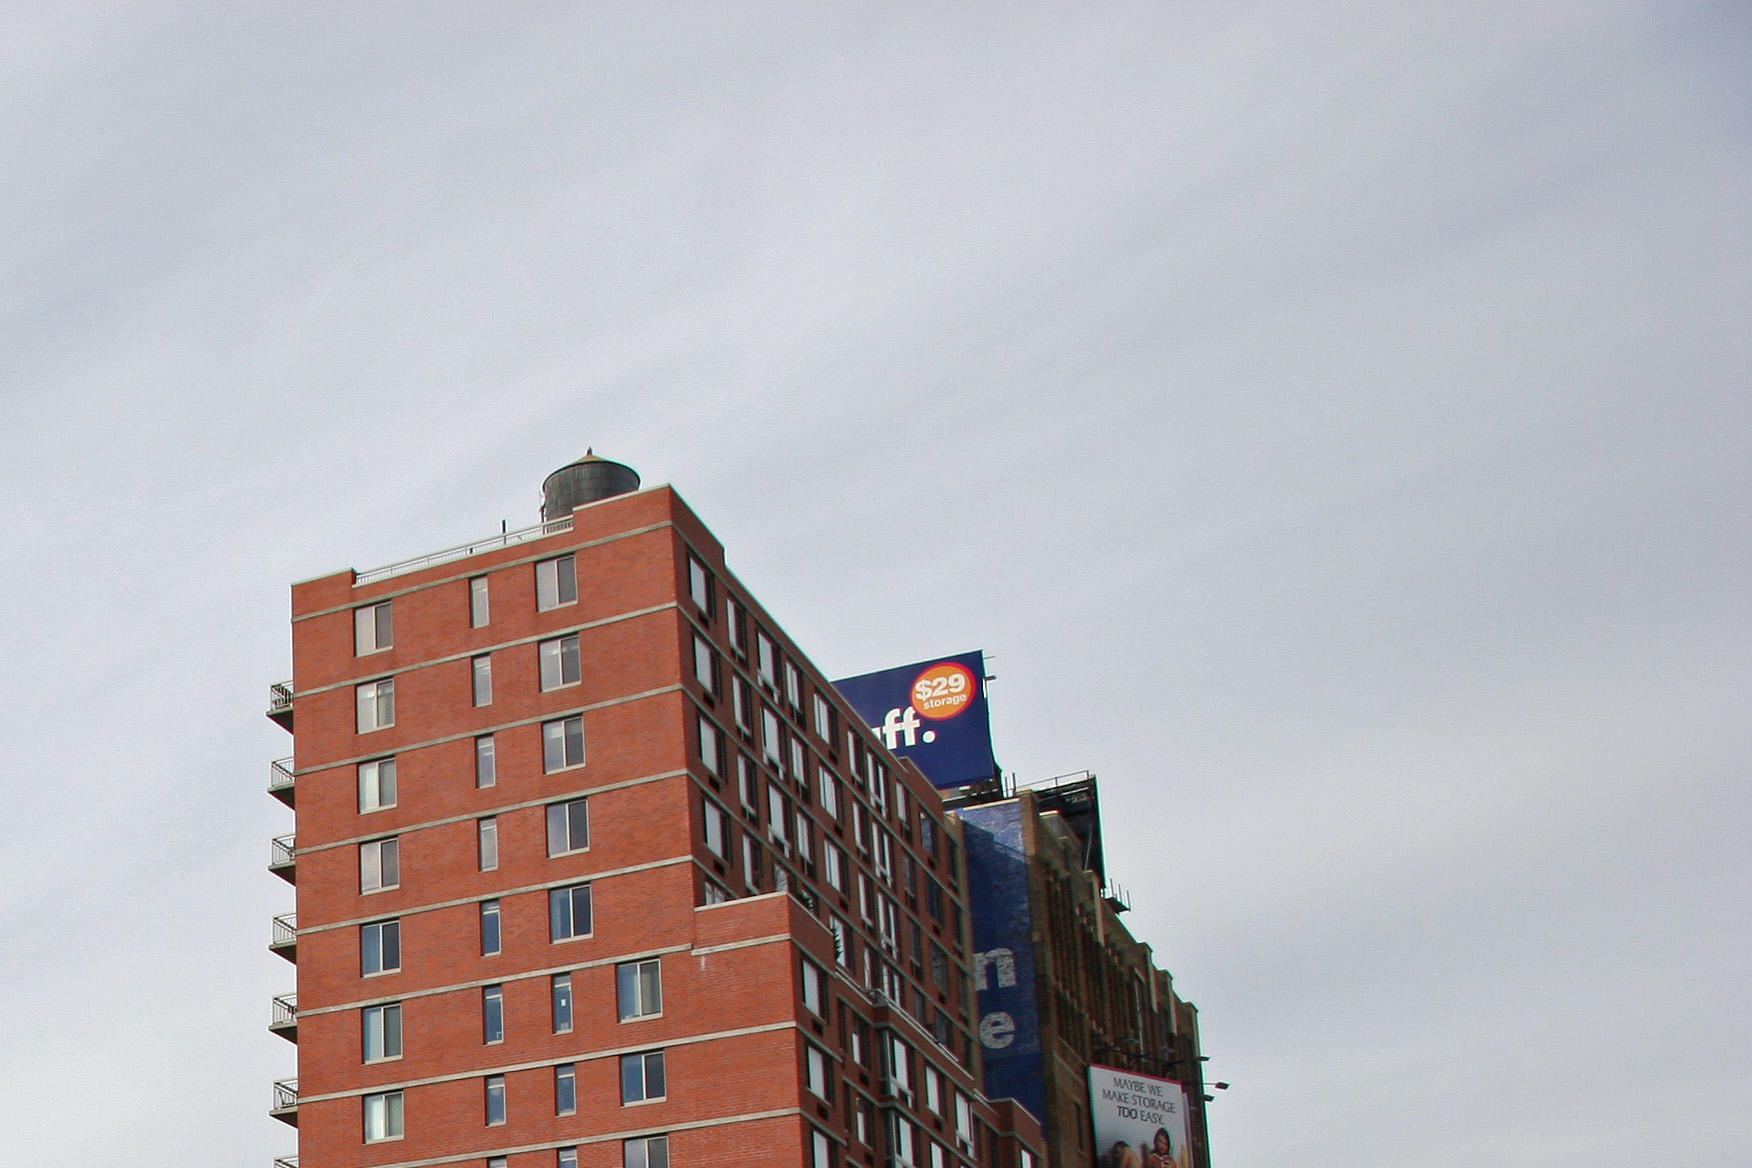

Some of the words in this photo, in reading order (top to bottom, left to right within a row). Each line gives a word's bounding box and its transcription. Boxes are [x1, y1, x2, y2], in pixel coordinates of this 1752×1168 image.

[914, 673, 967, 701] $29
[923, 694, 968, 710] storage
[1113, 1077, 1146, 1094] MAYBE
[1148, 1085, 1163, 1097] WE
[1102, 1089, 1129, 1103] MAKE
[1132, 1094, 1176, 1114] STORAGE
[1117, 1105, 1138, 1119] TOO
